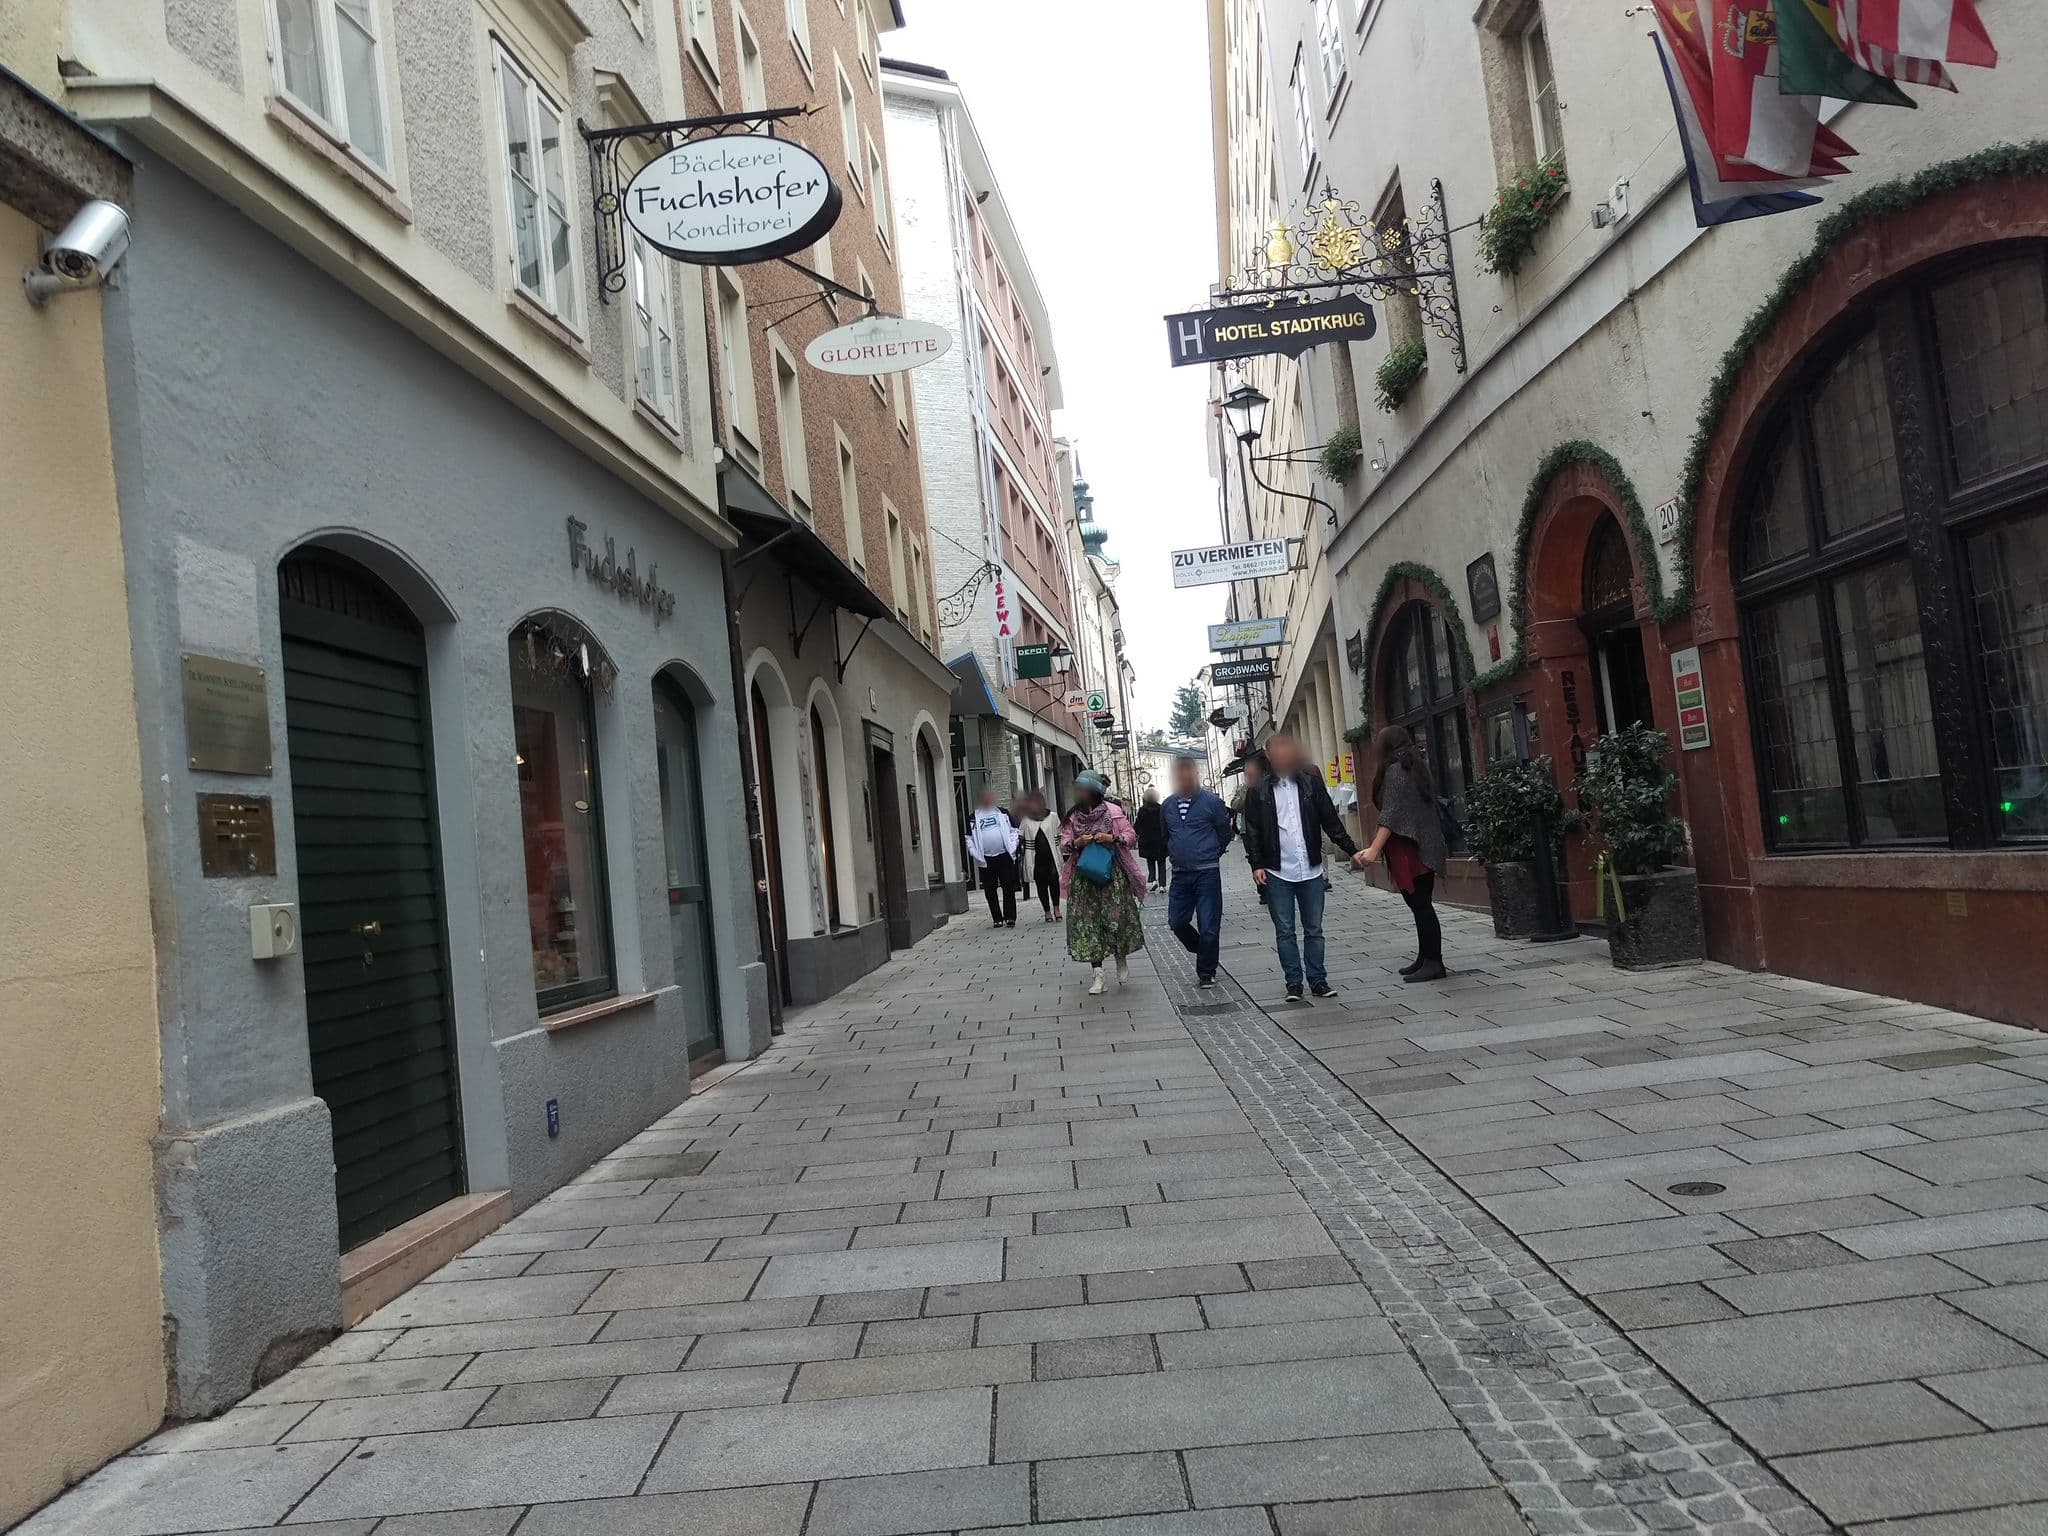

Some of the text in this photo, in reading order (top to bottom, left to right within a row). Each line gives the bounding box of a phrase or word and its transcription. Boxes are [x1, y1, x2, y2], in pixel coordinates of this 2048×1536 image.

[669, 147, 784, 176] Bäckerei
[634, 170, 820, 215] Fuchshofer
[667, 212, 793, 242] Konditorei
[1178, 318, 1203, 357] H
[1214, 311, 1366, 342] HOTEL STADTKRUG
[820, 338, 938, 364] GLORIETTE
[1660, 504, 1674, 530] 20
[1174, 541, 1283, 567] ZU VERMIETEN
[995, 582, 1010, 636] SEWA
[1018, 647, 1048, 656] DEPOT
[1070, 696, 1083, 704] dm
